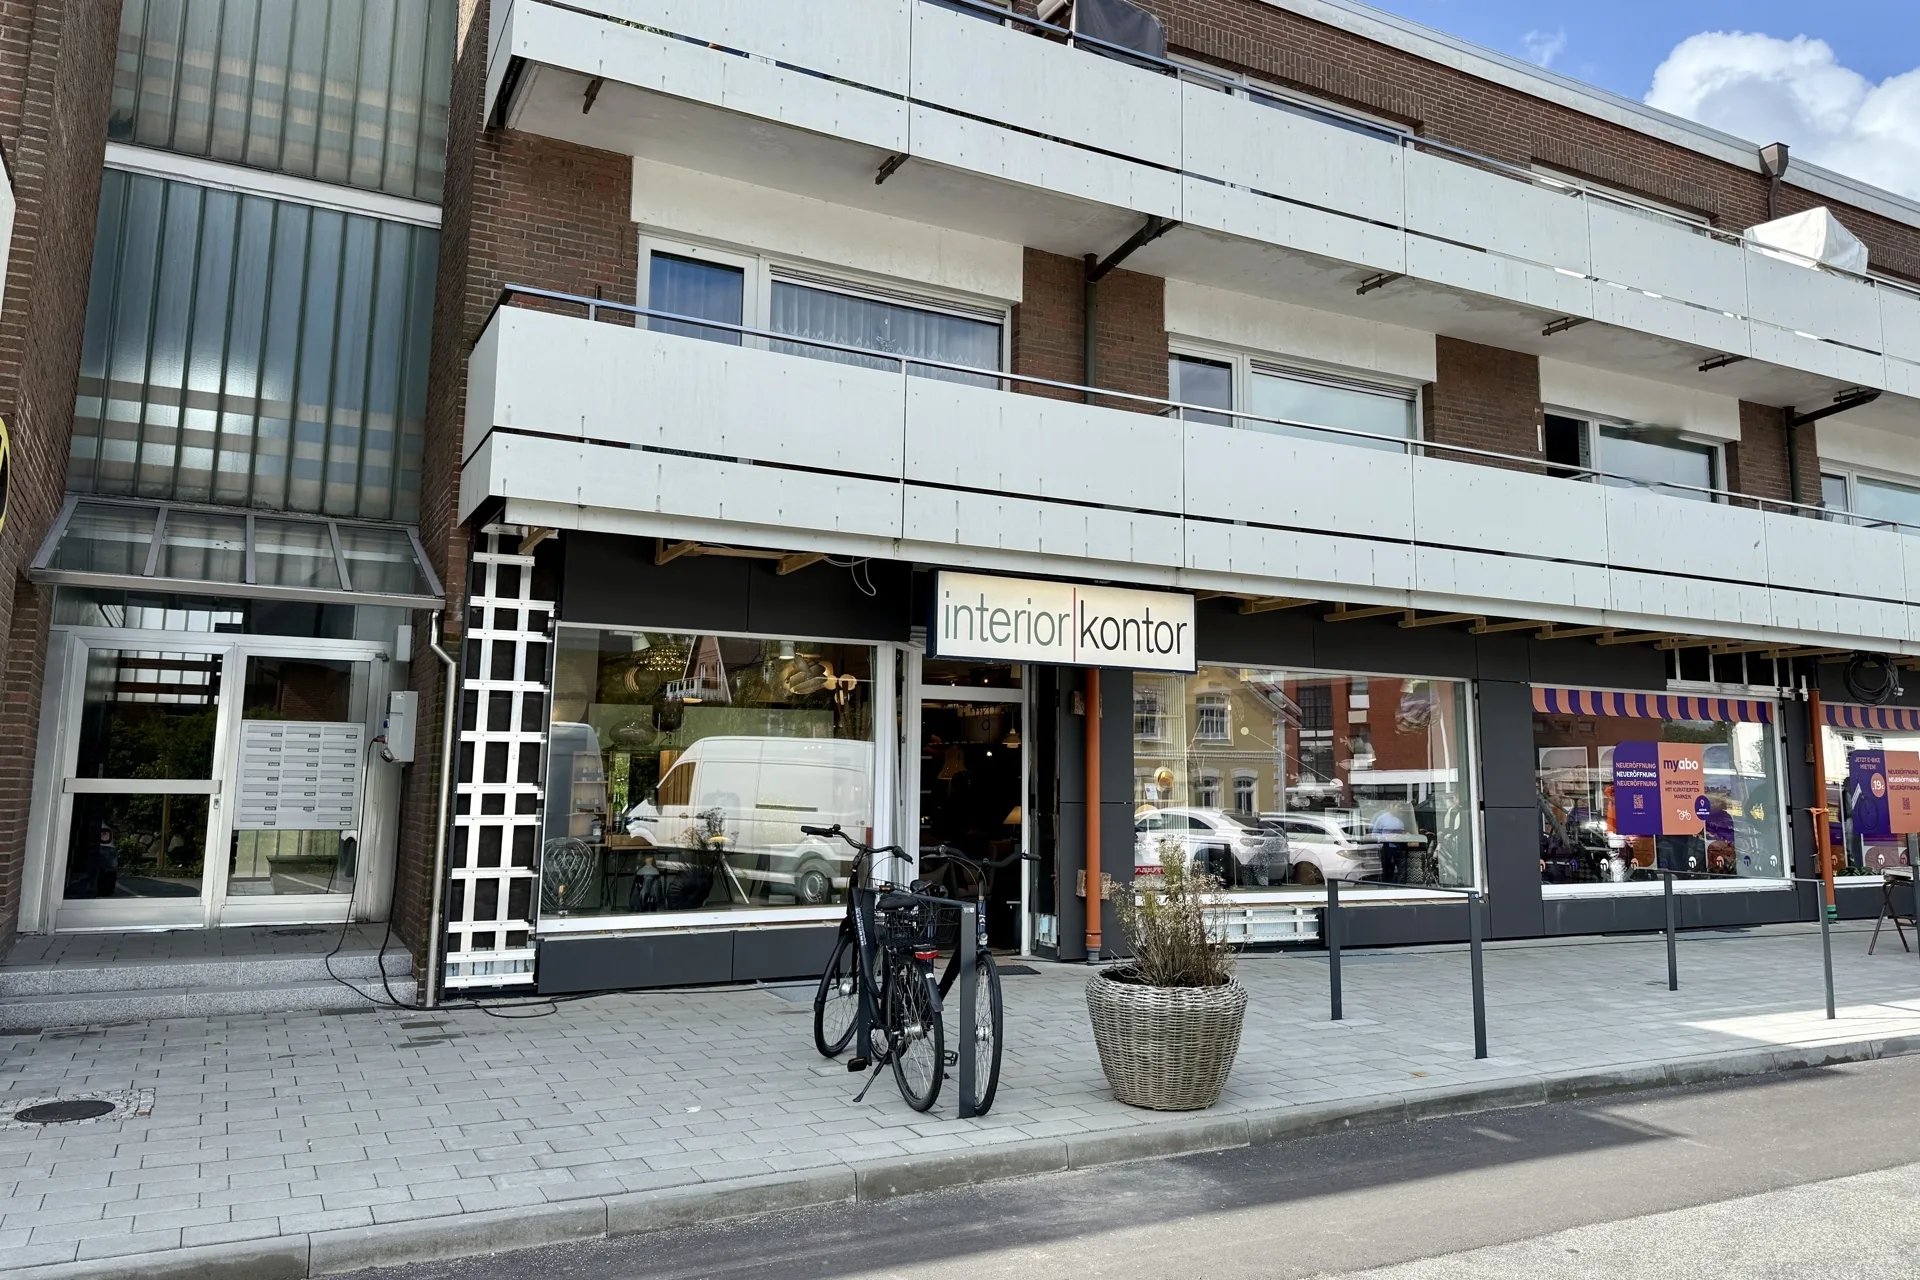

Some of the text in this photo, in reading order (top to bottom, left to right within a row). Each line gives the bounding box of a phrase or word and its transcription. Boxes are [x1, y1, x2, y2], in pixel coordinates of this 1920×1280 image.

[944, 590, 1188, 655] interior kontor
[1615, 761, 1657, 769] NEUERÖFFNUNG
[1663, 757, 1699, 772] myabo
[1616, 769, 1657, 778] NEUERÖFFNUNG
[1616, 778, 1658, 787] NEUERÖFFNUNG
